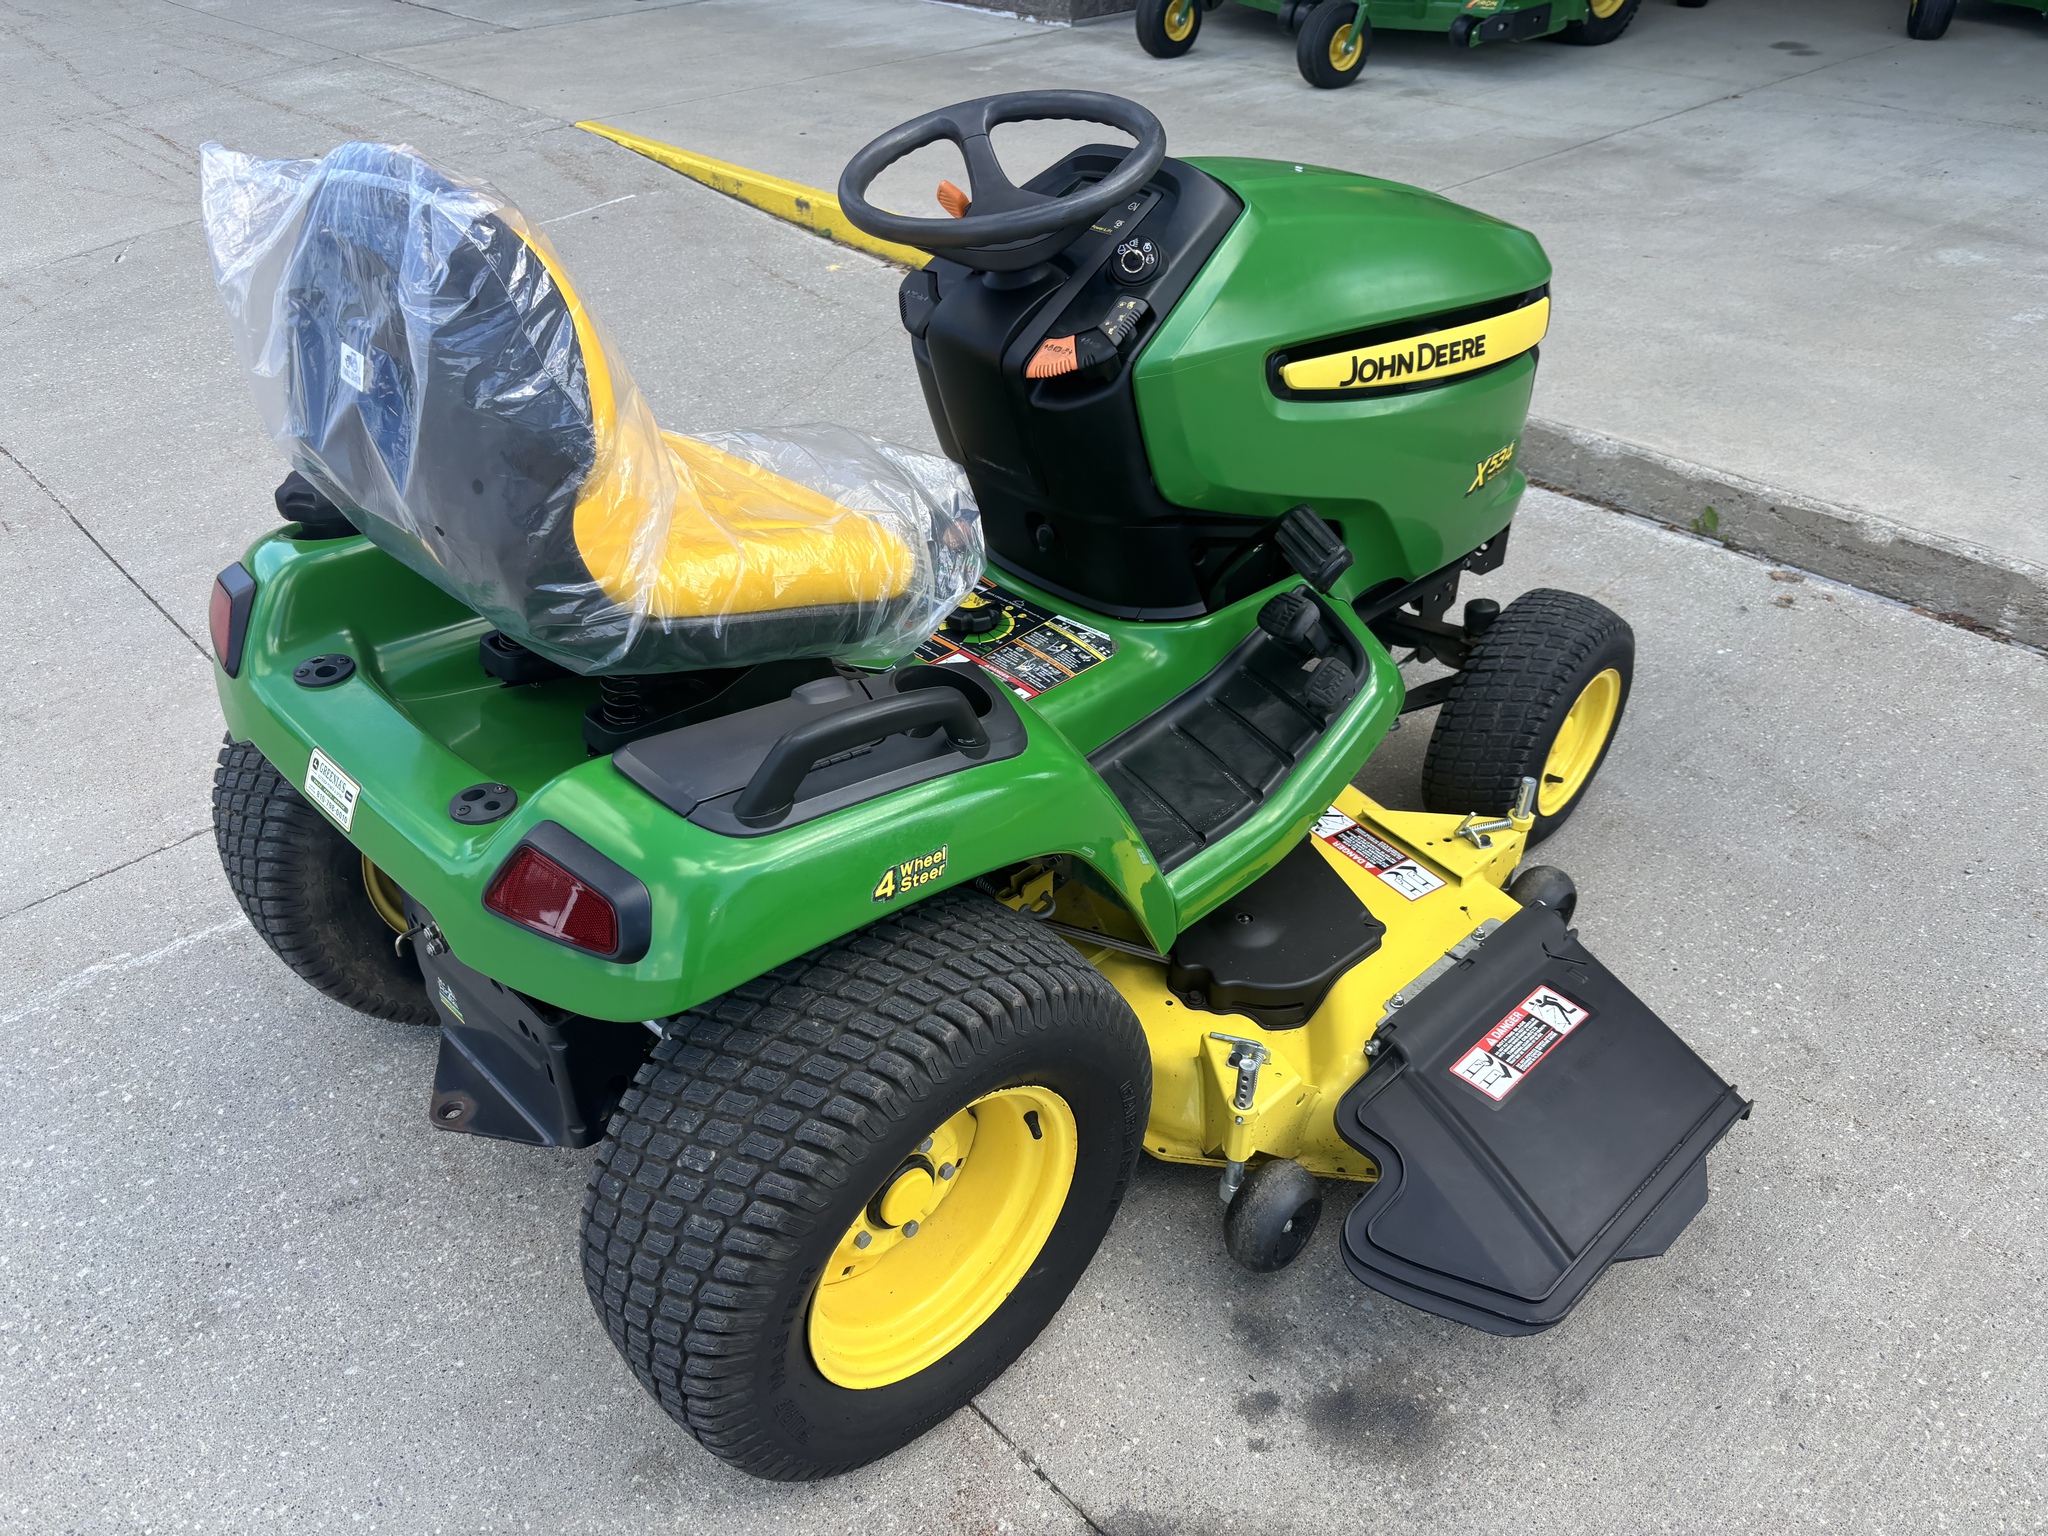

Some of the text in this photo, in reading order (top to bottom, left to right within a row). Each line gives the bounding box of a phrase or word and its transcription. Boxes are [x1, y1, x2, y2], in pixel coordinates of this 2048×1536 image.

[1339, 334, 1486, 387] JOHN DEERE
[1466, 442, 1515, 494] X534
[874, 845, 946, 898] 4 Wheel
[1332, 840, 1366, 864] DANGER
[900, 864, 946, 892] Steer
[1491, 1011, 1524, 1038] DANGER
